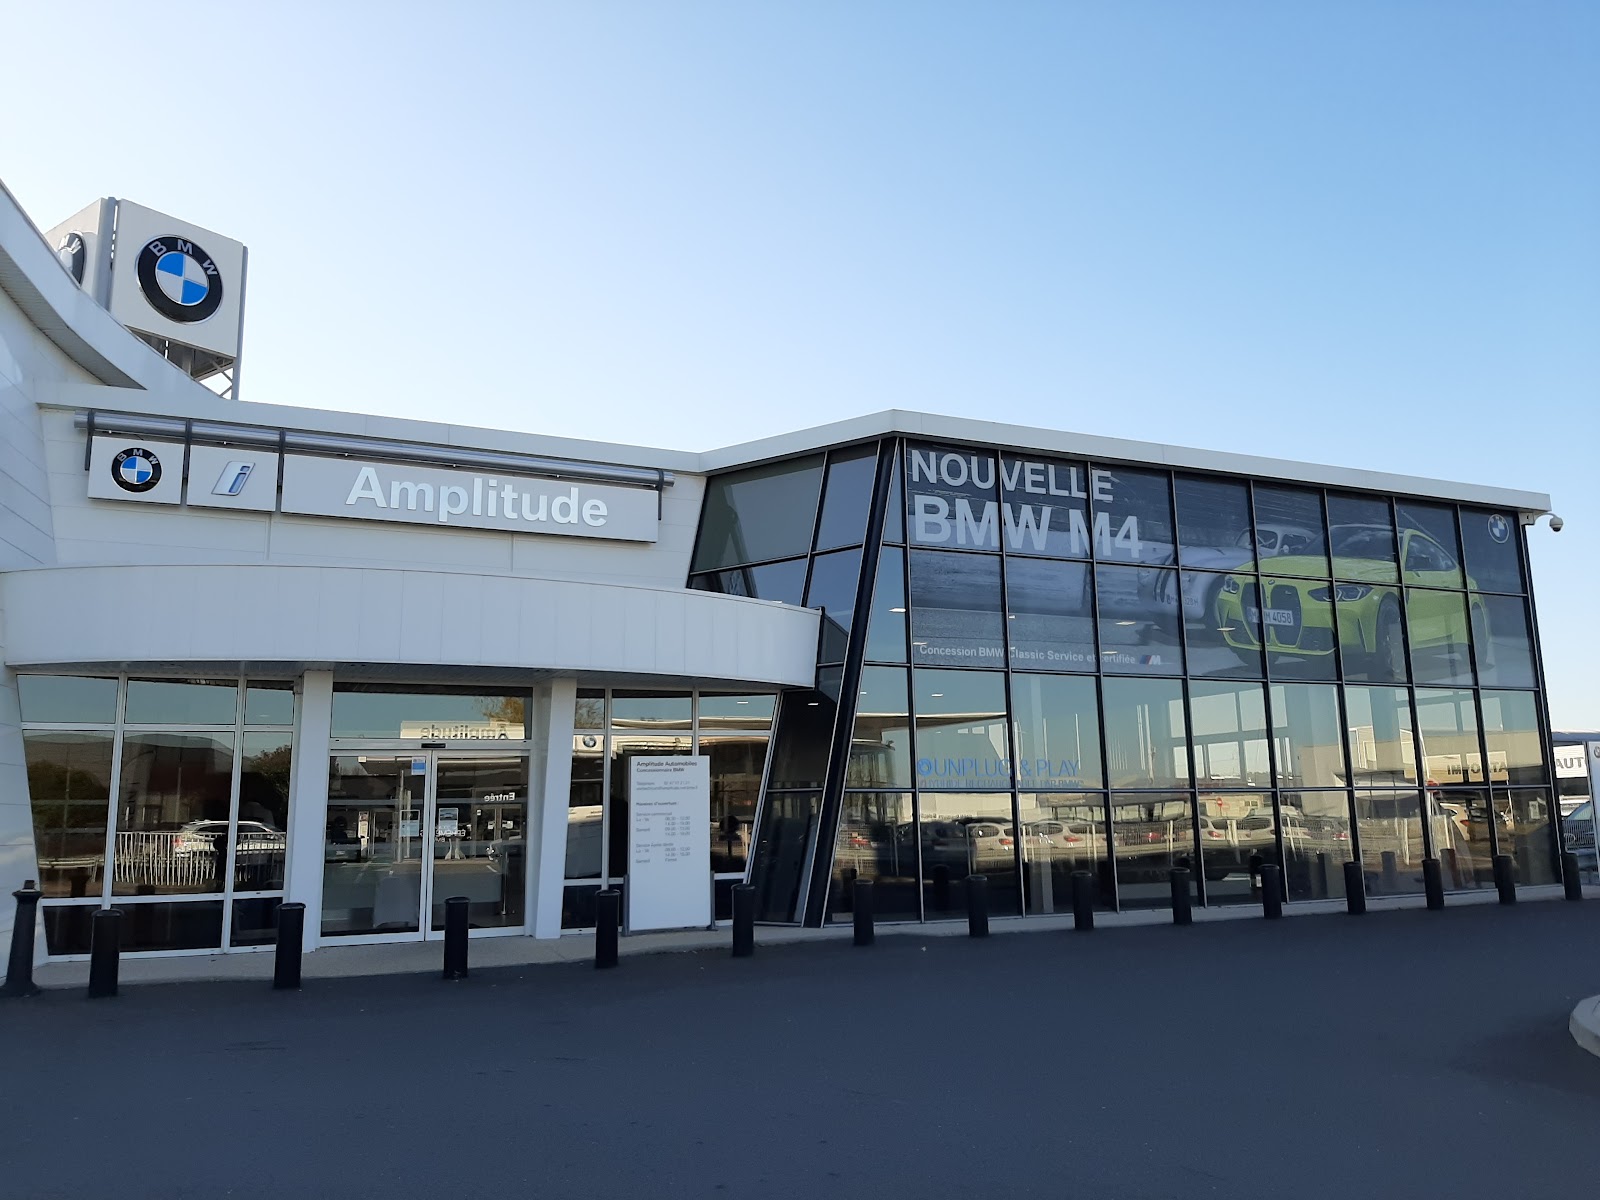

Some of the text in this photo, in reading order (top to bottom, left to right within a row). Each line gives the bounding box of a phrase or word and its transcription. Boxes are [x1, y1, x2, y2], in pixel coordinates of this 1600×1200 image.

[149, 239, 218, 276] BMW
[117, 449, 159, 465] BMW
[911, 450, 1114, 502] NOUVELLE
[345, 466, 609, 527] Amplitude
[914, 494, 1143, 559] BMW M4
[919, 644, 977, 657] Concession
[979, 647, 1005, 658] BMW
[1047, 651, 1084, 661] Service
[1036, 758, 1080, 777] PLAY
[1555, 757, 1586, 770] AUT
